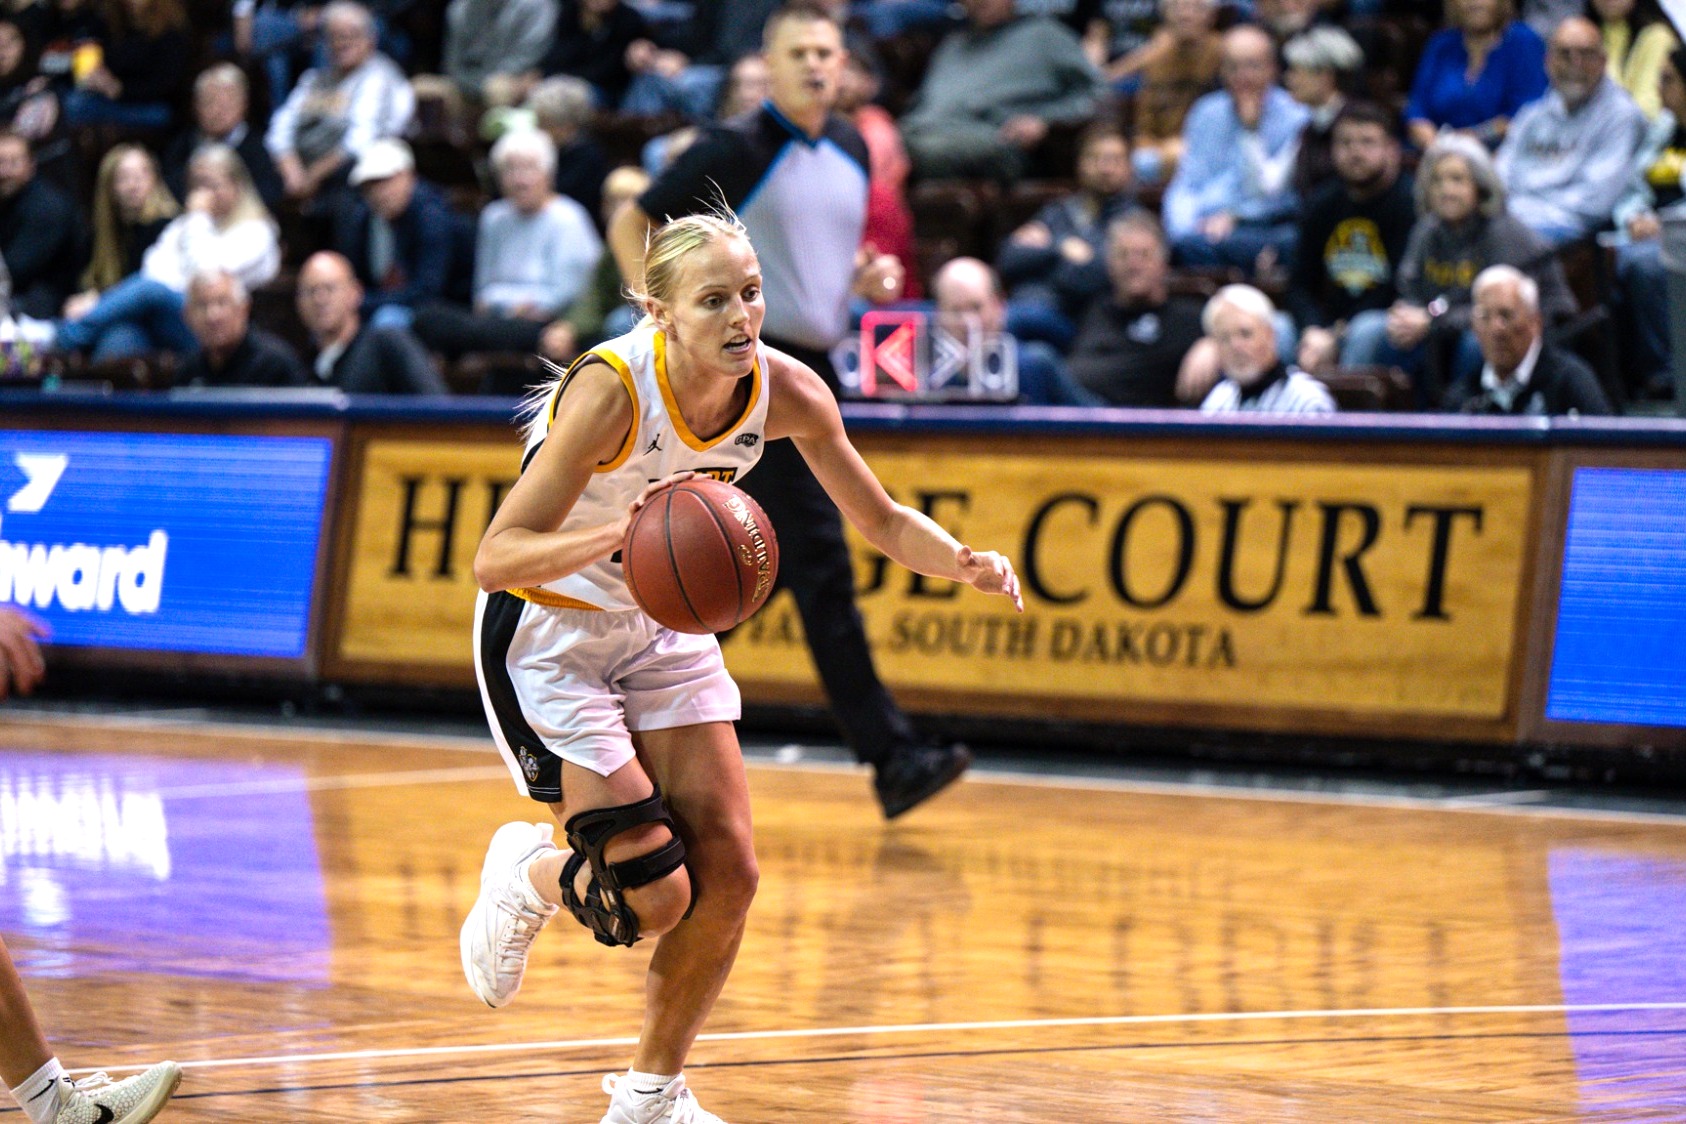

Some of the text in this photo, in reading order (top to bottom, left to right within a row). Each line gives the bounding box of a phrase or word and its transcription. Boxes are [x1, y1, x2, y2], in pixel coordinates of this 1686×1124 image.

[1021, 491, 1484, 622] COURT
[891, 612, 1237, 668] SOUTH DAKOTA
